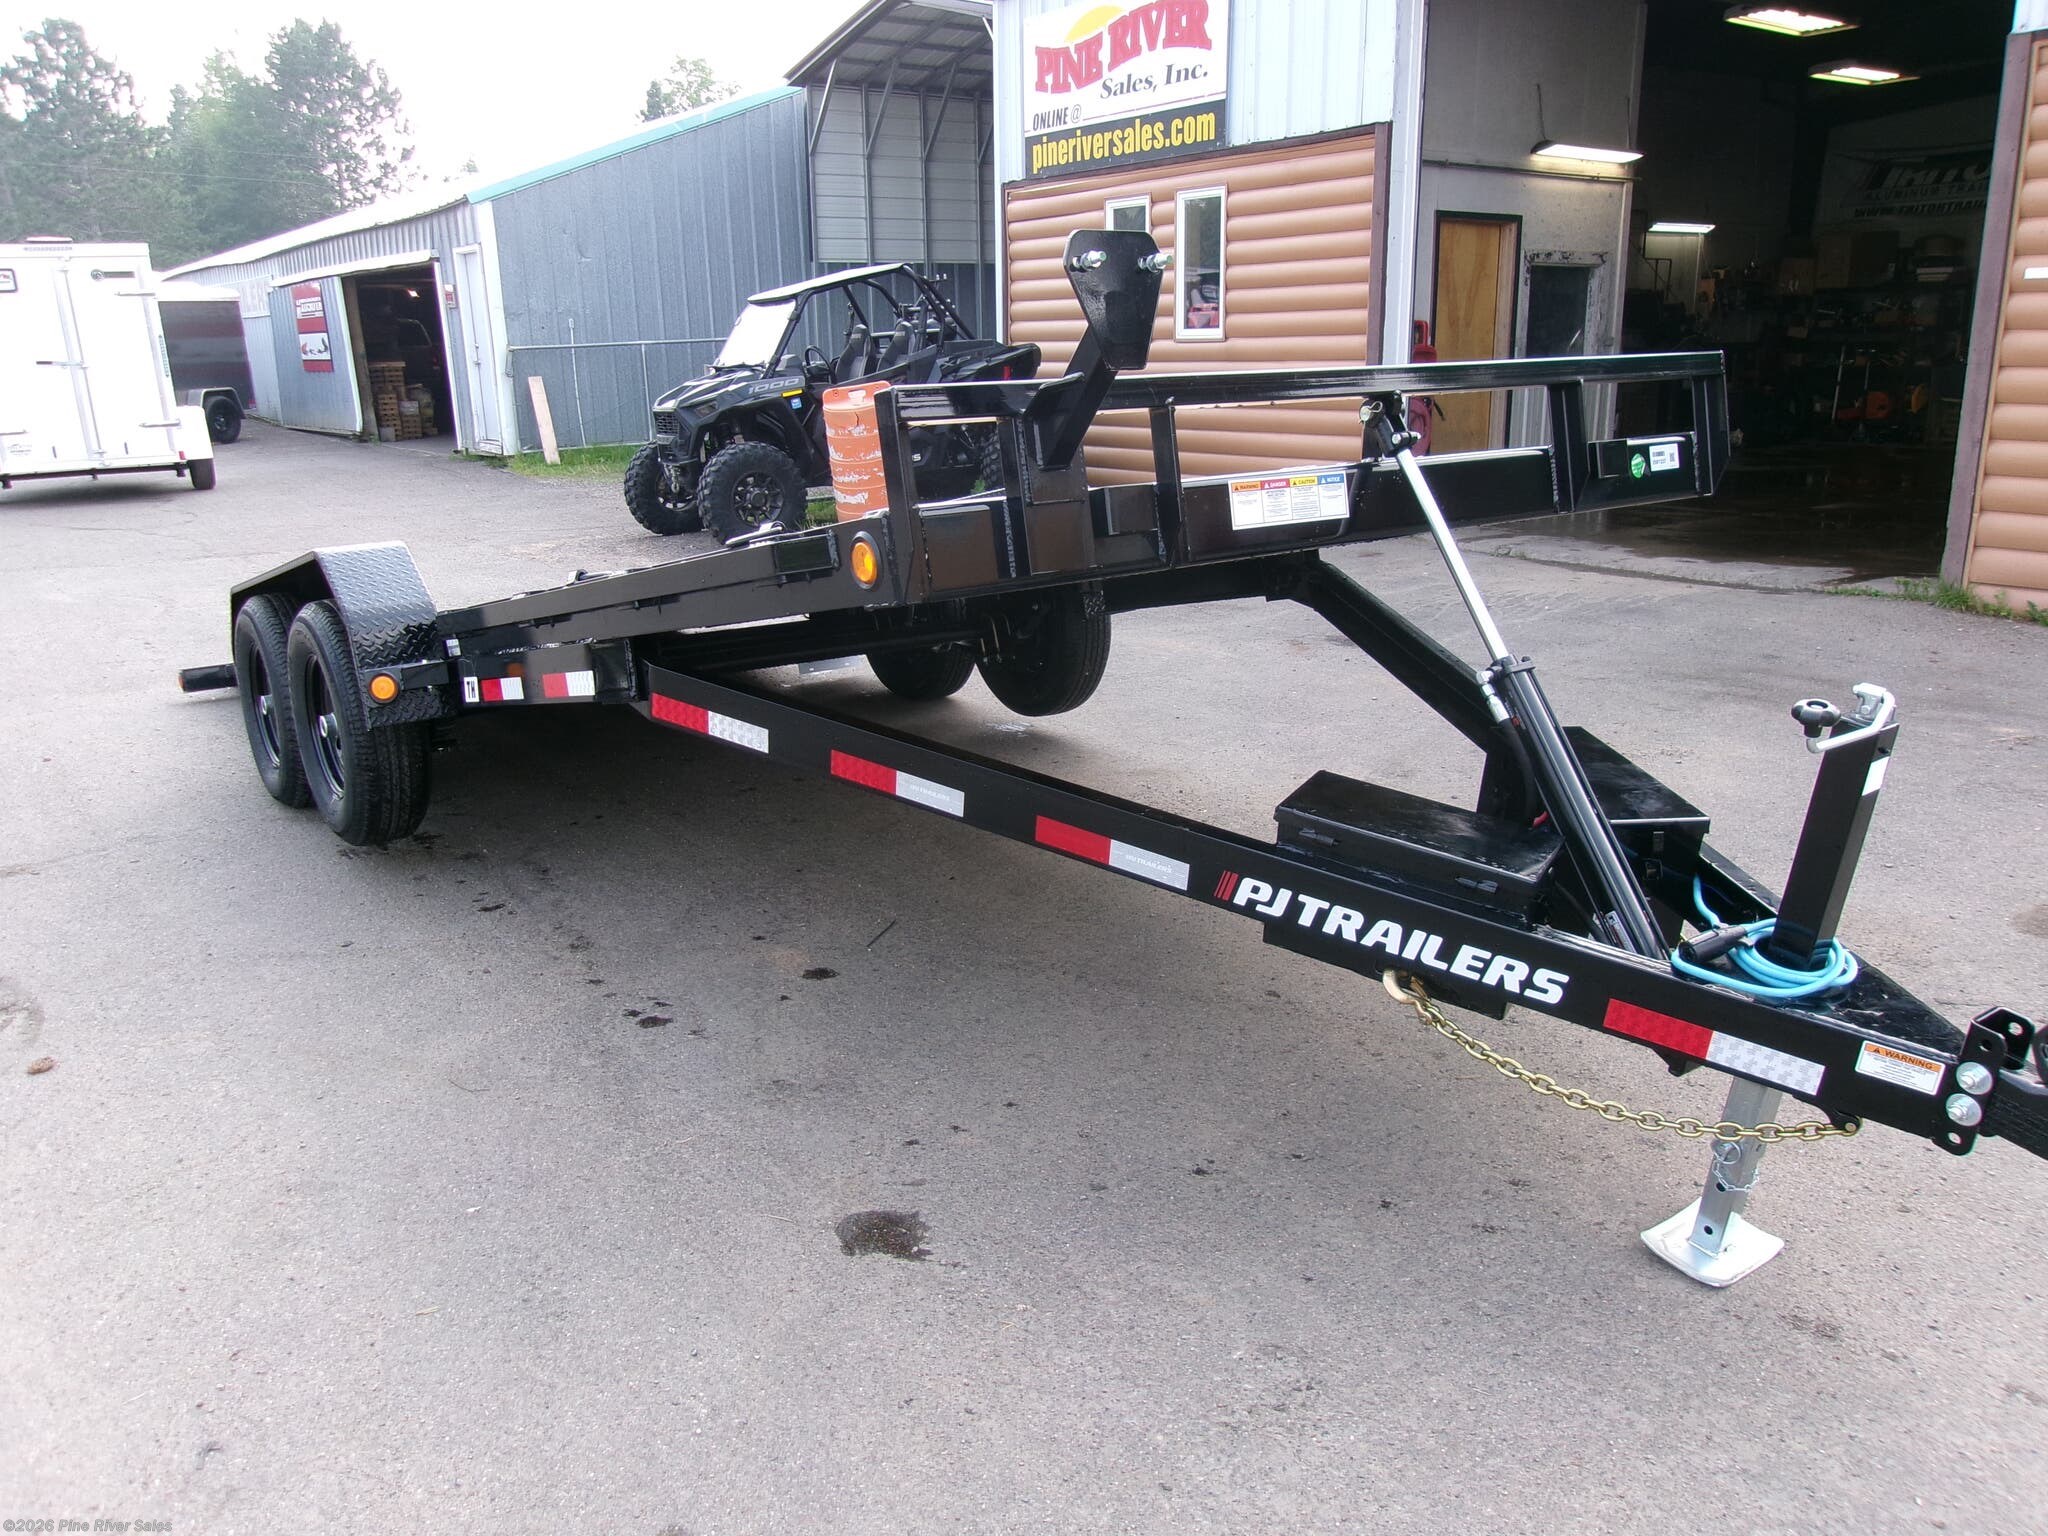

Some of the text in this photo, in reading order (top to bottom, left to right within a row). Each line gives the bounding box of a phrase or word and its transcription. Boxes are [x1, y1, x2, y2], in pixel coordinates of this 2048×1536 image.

[1035, 0, 1212, 94] PINE RIVER
[1100, 62, 1208, 99] Sales, Inc.
[1033, 103, 1082, 132] ONLINE @
[1032, 111, 1216, 174] pineriversales.com
[748, 378, 800, 395] 1000
[1233, 876, 1293, 918] PJ
[1297, 894, 1570, 1005] TRAILERS
[1885, 1049, 1934, 1070] WARNING
